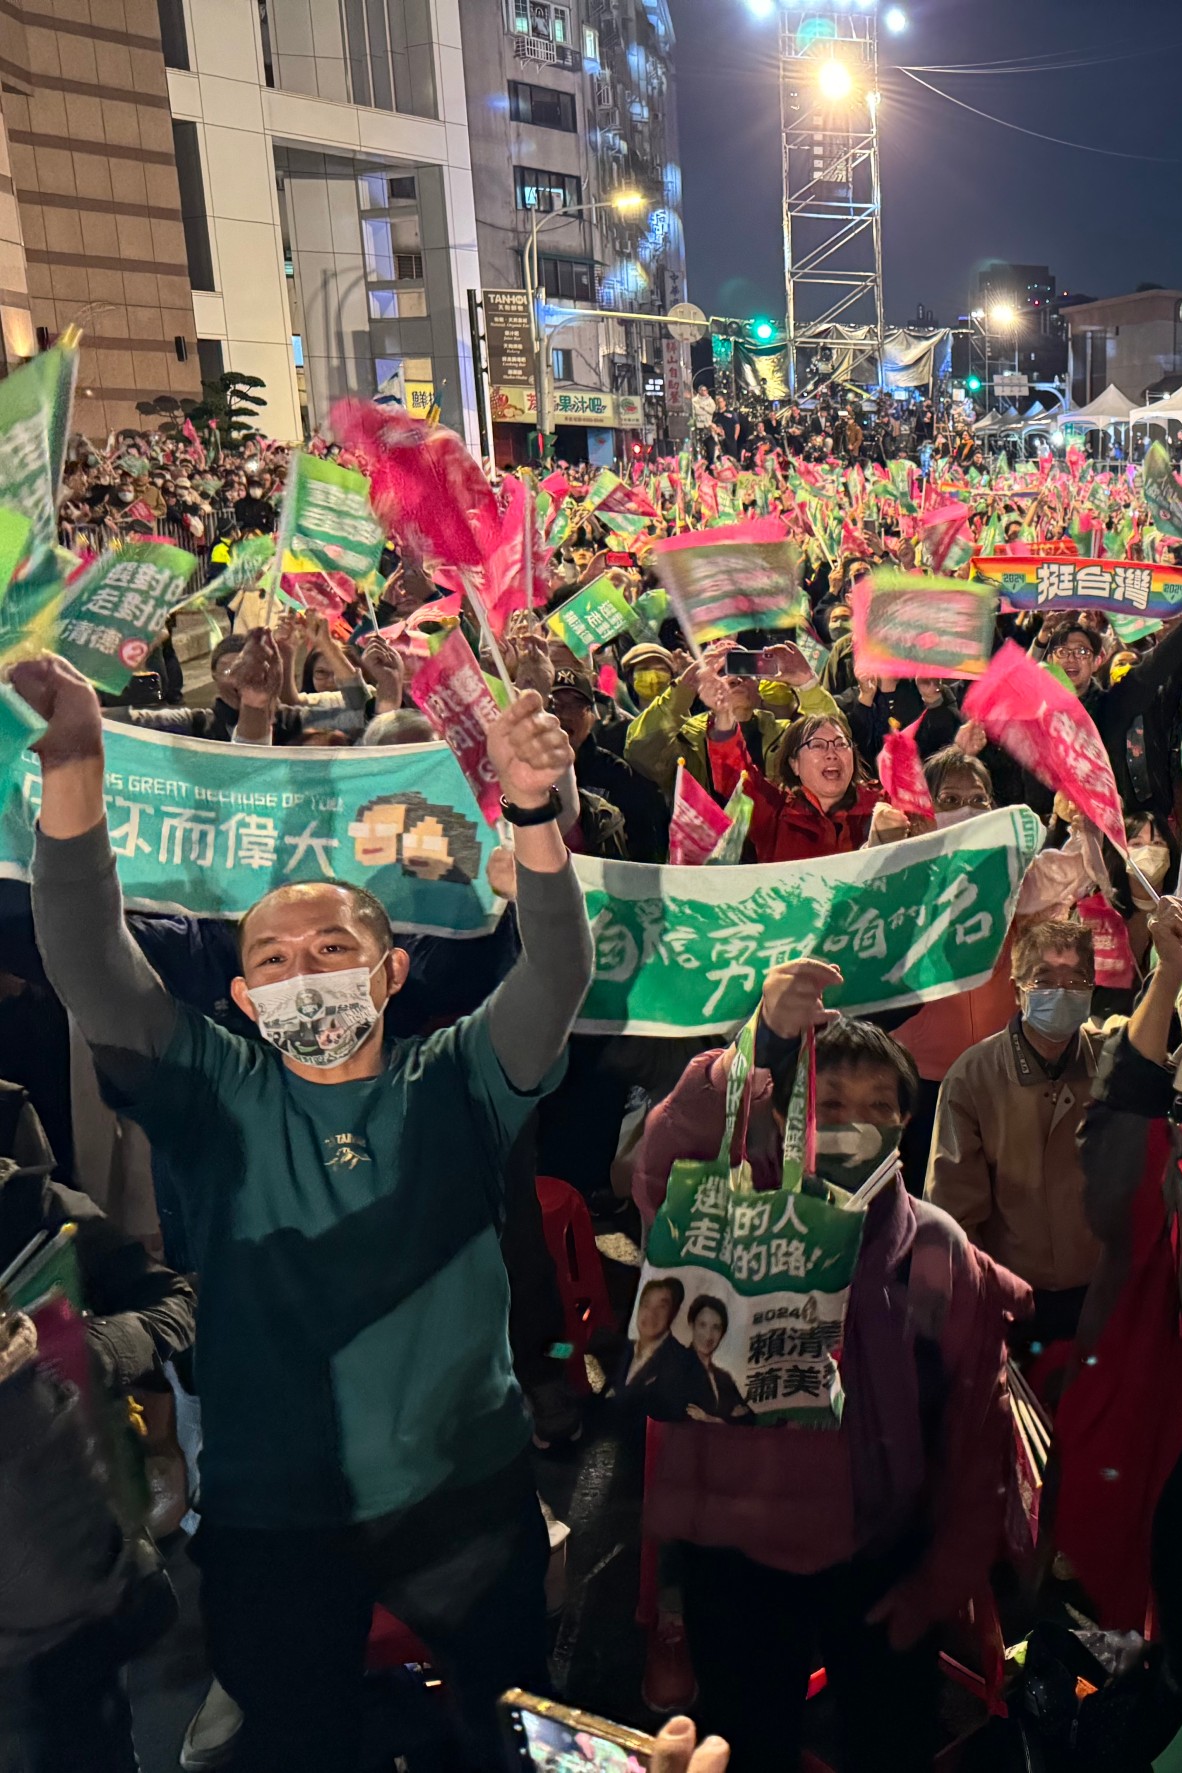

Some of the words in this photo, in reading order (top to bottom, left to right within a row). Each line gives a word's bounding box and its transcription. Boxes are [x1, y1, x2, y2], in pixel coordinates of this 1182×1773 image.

[1003, 573, 1026, 584] 2024
[1036, 563, 1153, 609] 挺台灣
[557, 670, 575, 685] NY
[128, 776, 190, 799] GREAT
[690, 1176, 809, 1237] 選的人
[753, 1307, 801, 1325] 2024
